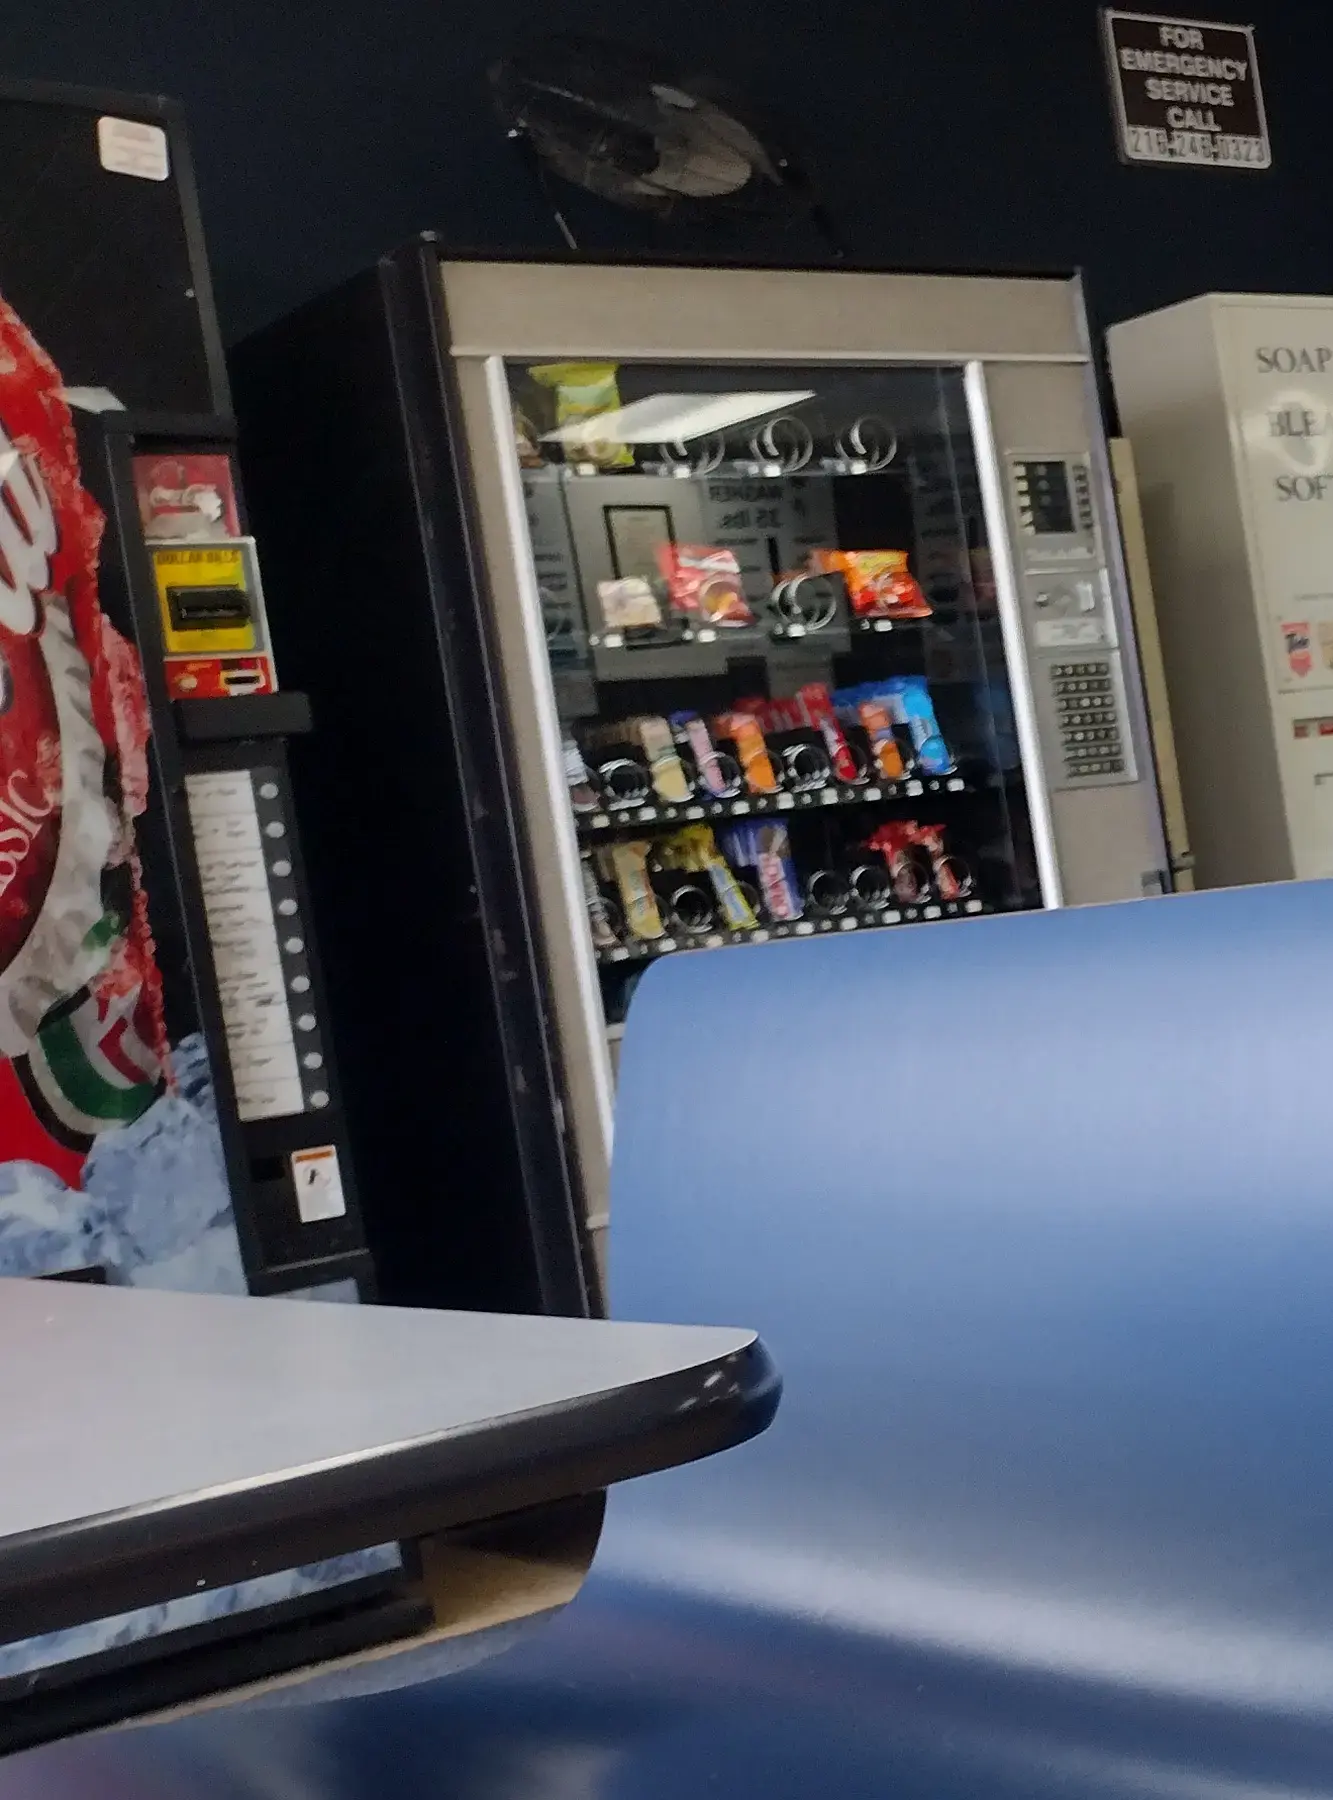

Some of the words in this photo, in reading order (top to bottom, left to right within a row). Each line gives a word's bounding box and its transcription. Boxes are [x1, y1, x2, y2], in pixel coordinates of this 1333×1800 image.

[1158, 25, 1205, 51] FOR
[1119, 47, 1248, 82] EMERGENCY
[1144, 77, 1235, 107] SERVICE
[1167, 105, 1223, 132] CALL
[1255, 345, 1333, 374] SOAP
